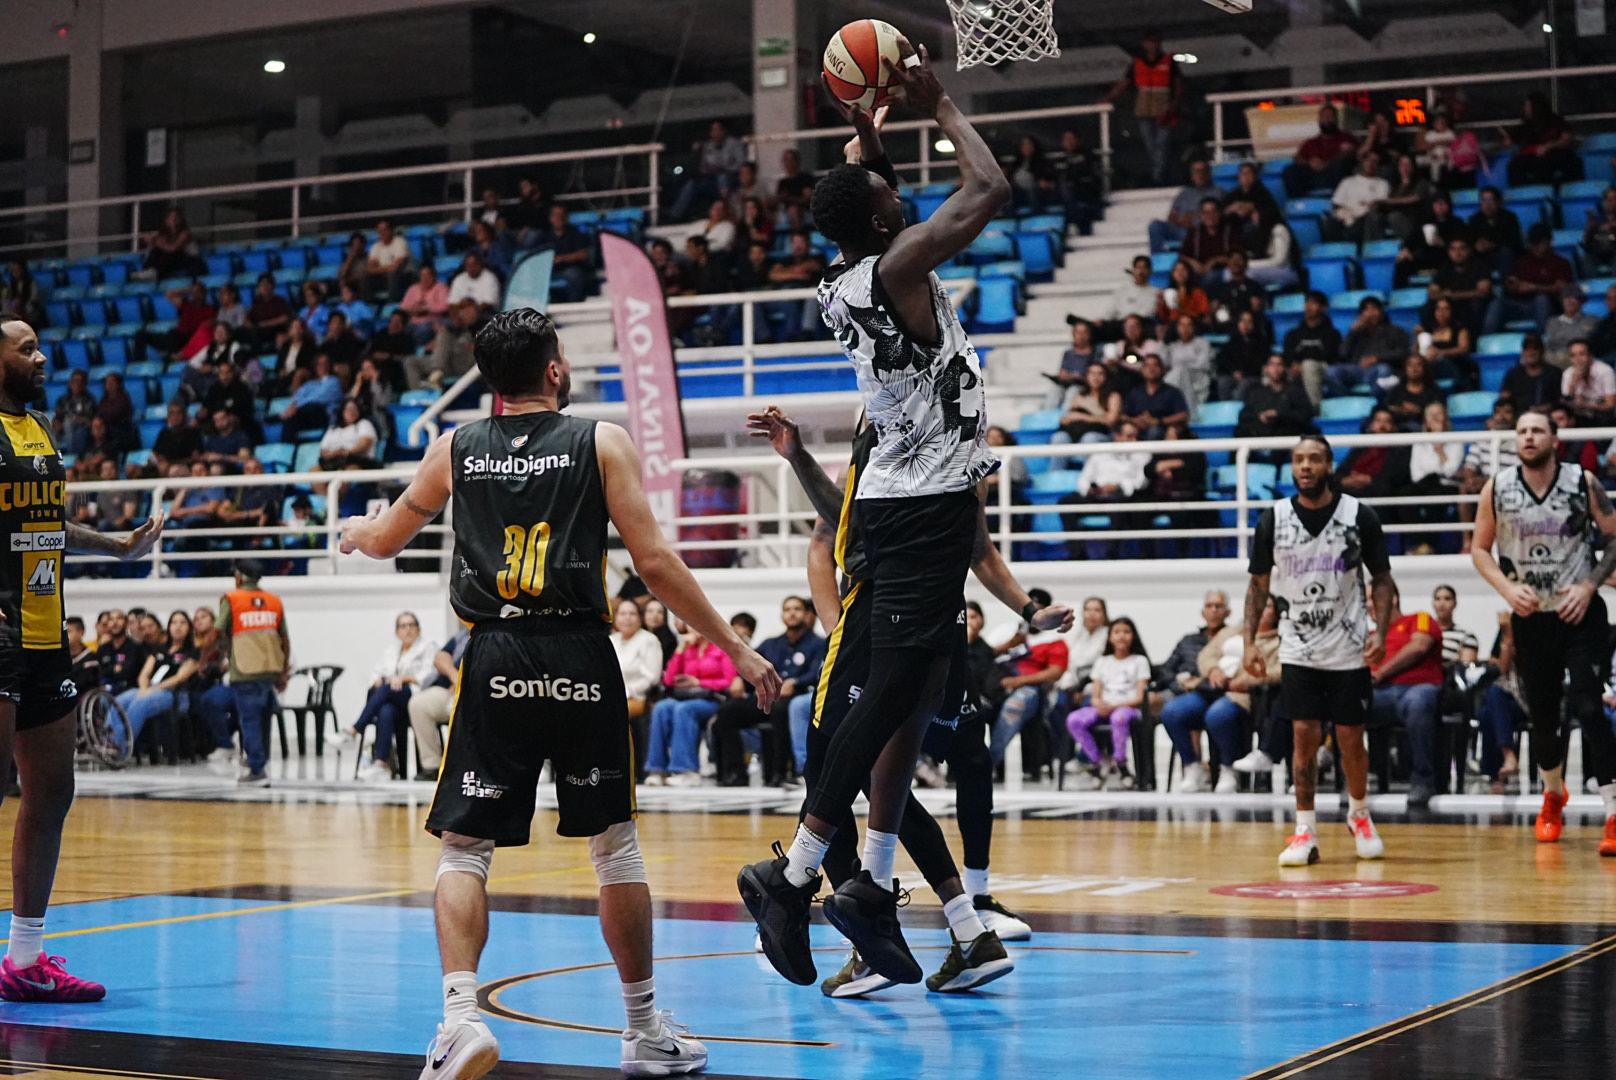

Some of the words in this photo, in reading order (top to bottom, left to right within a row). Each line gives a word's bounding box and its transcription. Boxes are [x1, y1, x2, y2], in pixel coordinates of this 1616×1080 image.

[826, 48, 846, 75] DING
[30, 509, 58, 519] TOWN
[37, 535, 64, 549] Coppe
[496, 521, 551, 600] 30
[489, 673, 602, 702] SoniGas
